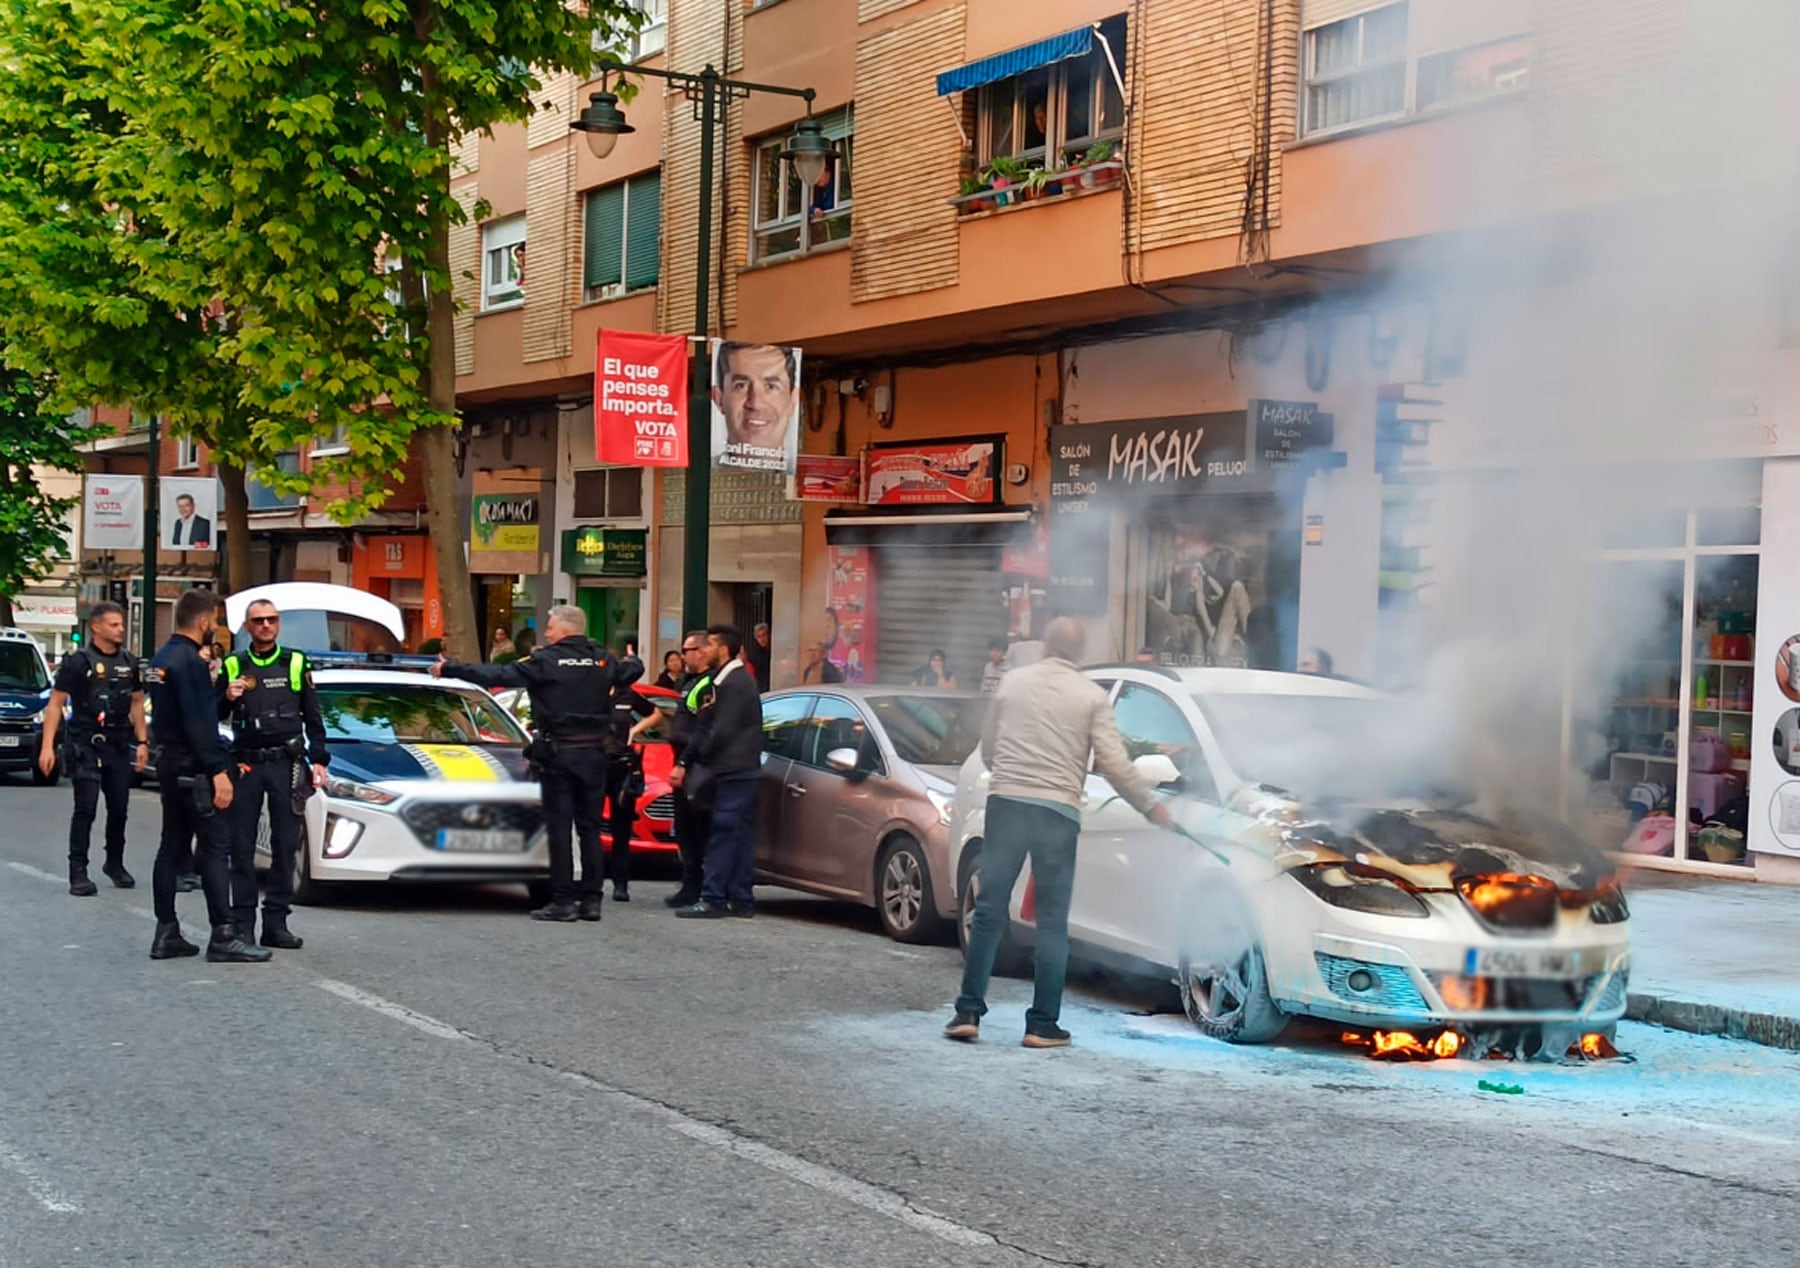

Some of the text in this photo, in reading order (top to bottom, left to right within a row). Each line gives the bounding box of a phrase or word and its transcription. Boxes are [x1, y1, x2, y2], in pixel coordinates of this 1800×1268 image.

[603, 357, 659, 379] El que
[603, 379, 669, 397] penses
[602, 397, 678, 416] importa.
[1262, 405, 1313, 424] MASAK
[635, 421, 677, 436] VOTA
[1060, 444, 1091, 459] SALÓN
[1107, 428, 1203, 483] MASAK
[1068, 464, 1081, 476] DE
[1052, 482, 1098, 495] ESTILISMO
[95, 502, 122, 510] VOTA
